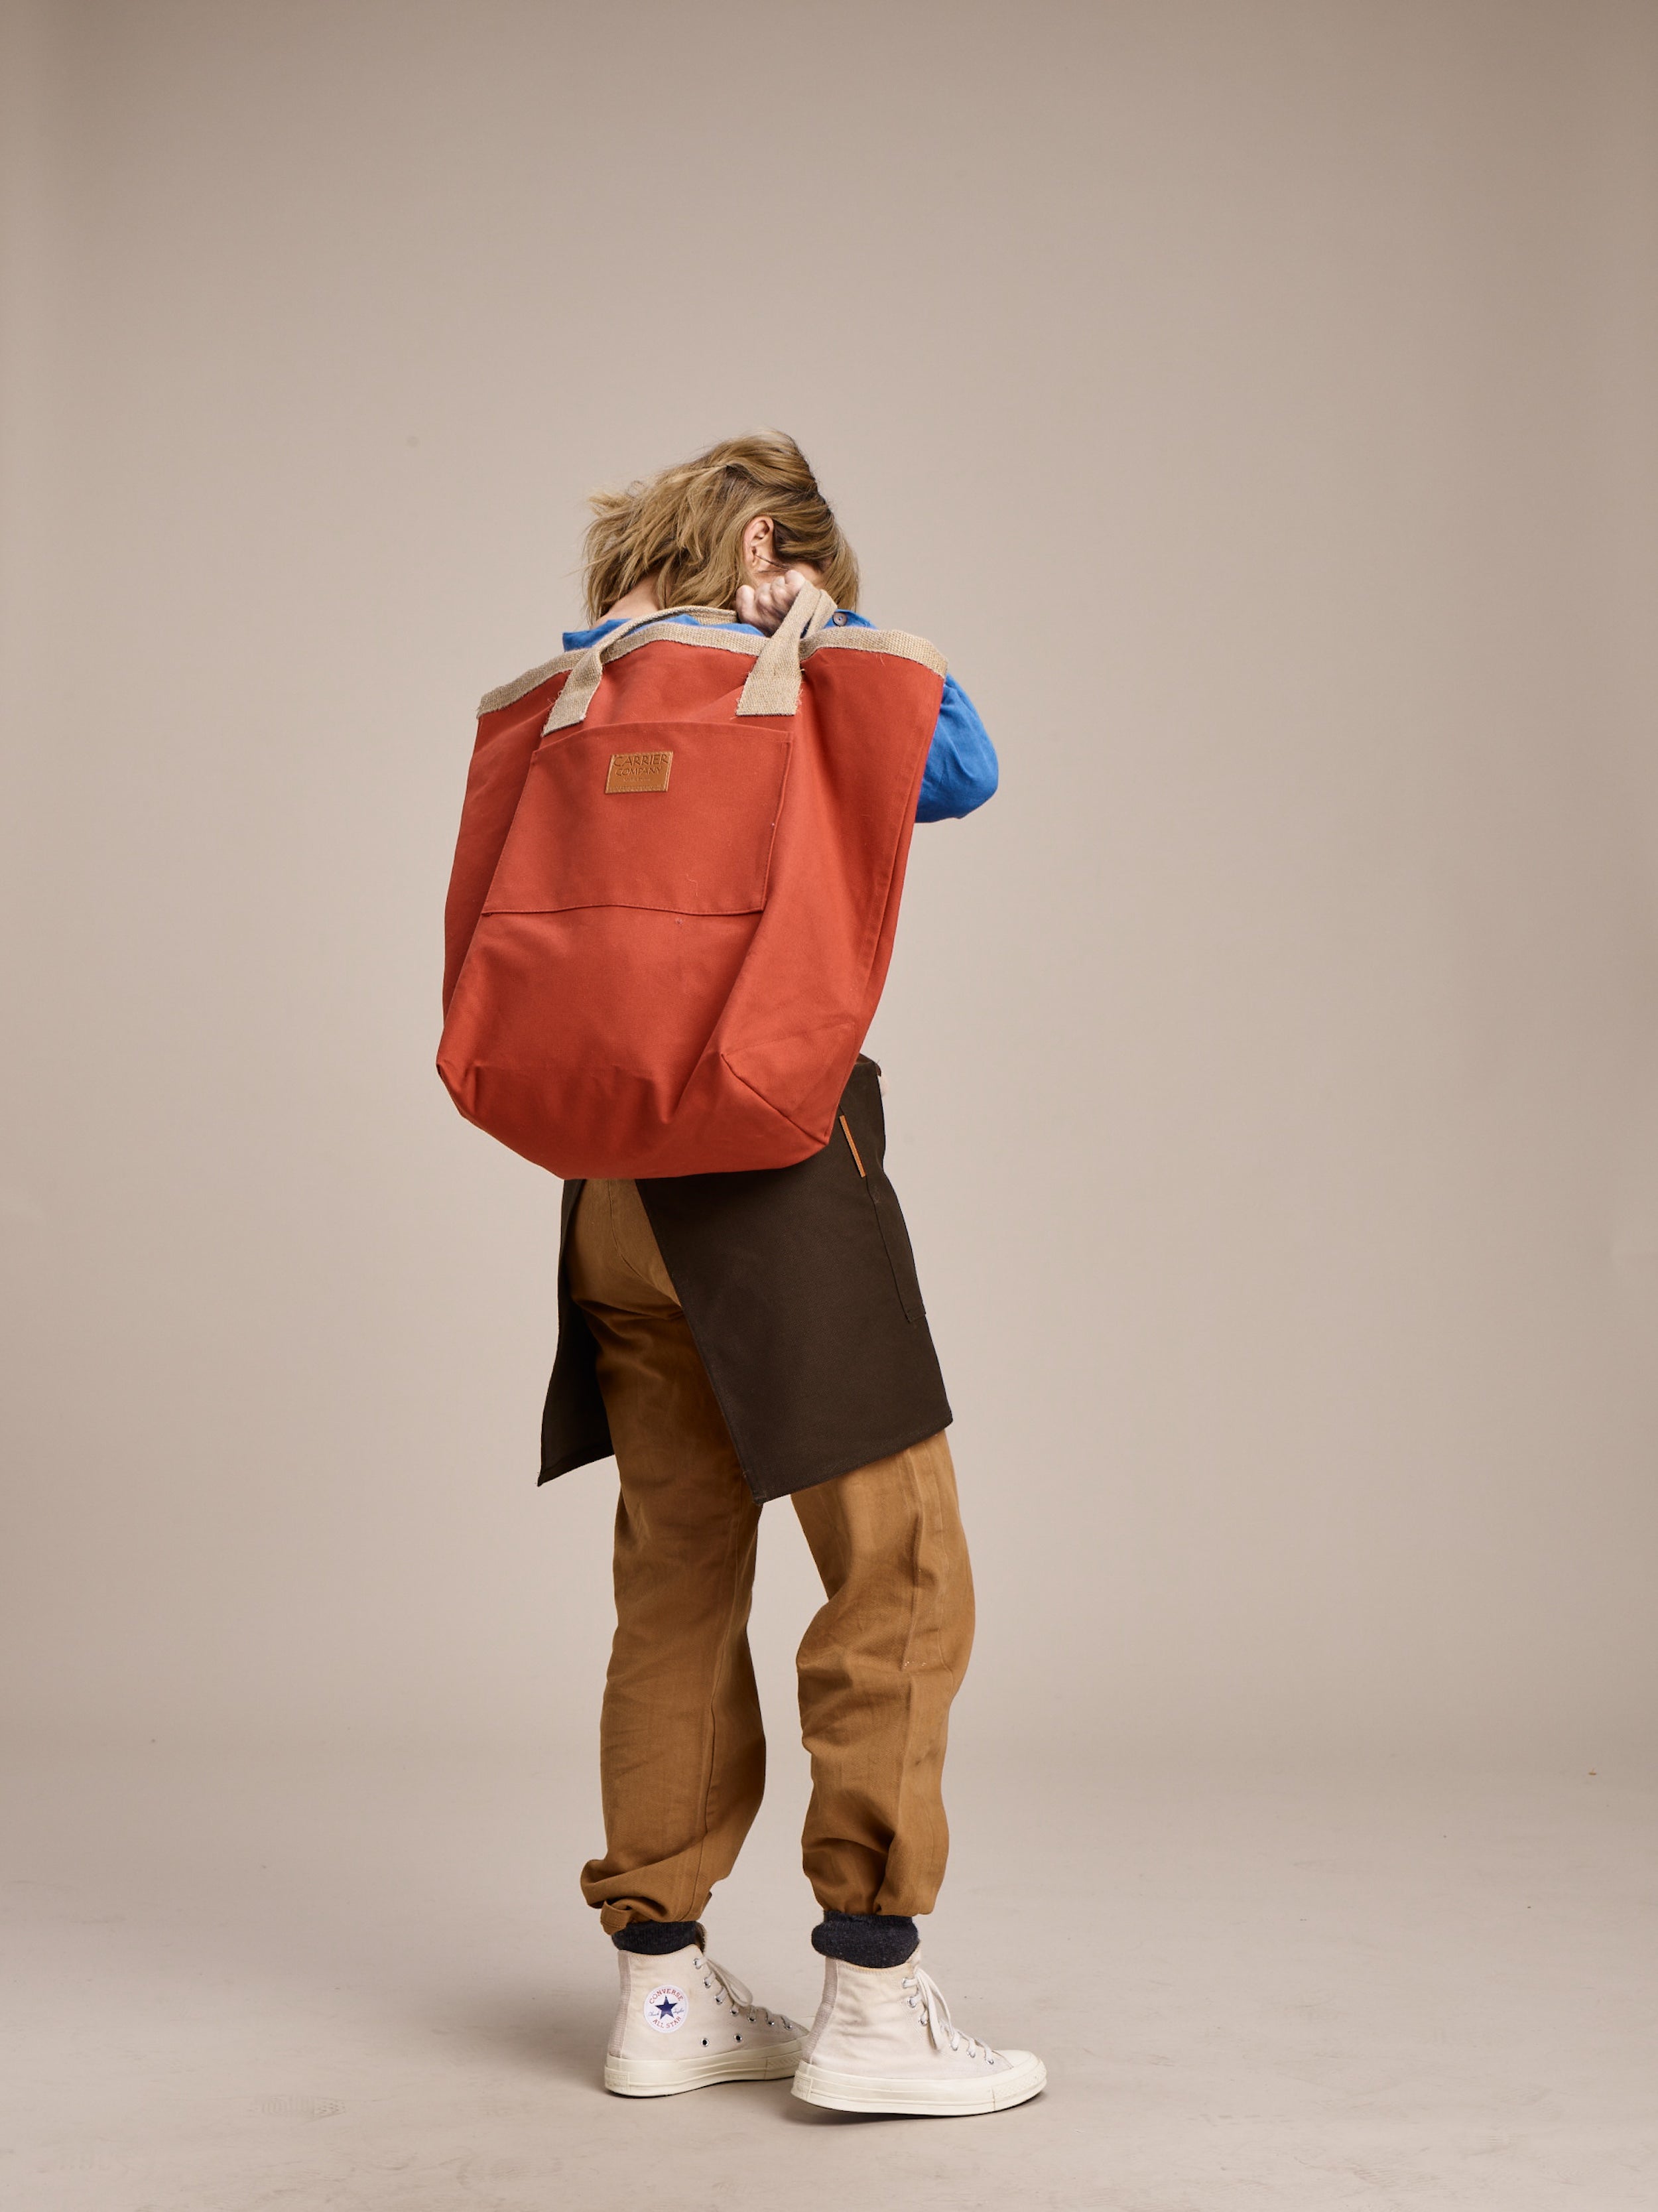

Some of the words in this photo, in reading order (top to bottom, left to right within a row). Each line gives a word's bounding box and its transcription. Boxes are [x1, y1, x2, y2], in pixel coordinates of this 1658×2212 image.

[613, 754, 669, 767] CARRIER
[615, 766, 662, 776] COMPANY
[649, 1988, 684, 2004] CONVERSE
[653, 2018, 664, 2028] ALL
[666, 2016, 681, 2028] STAR
